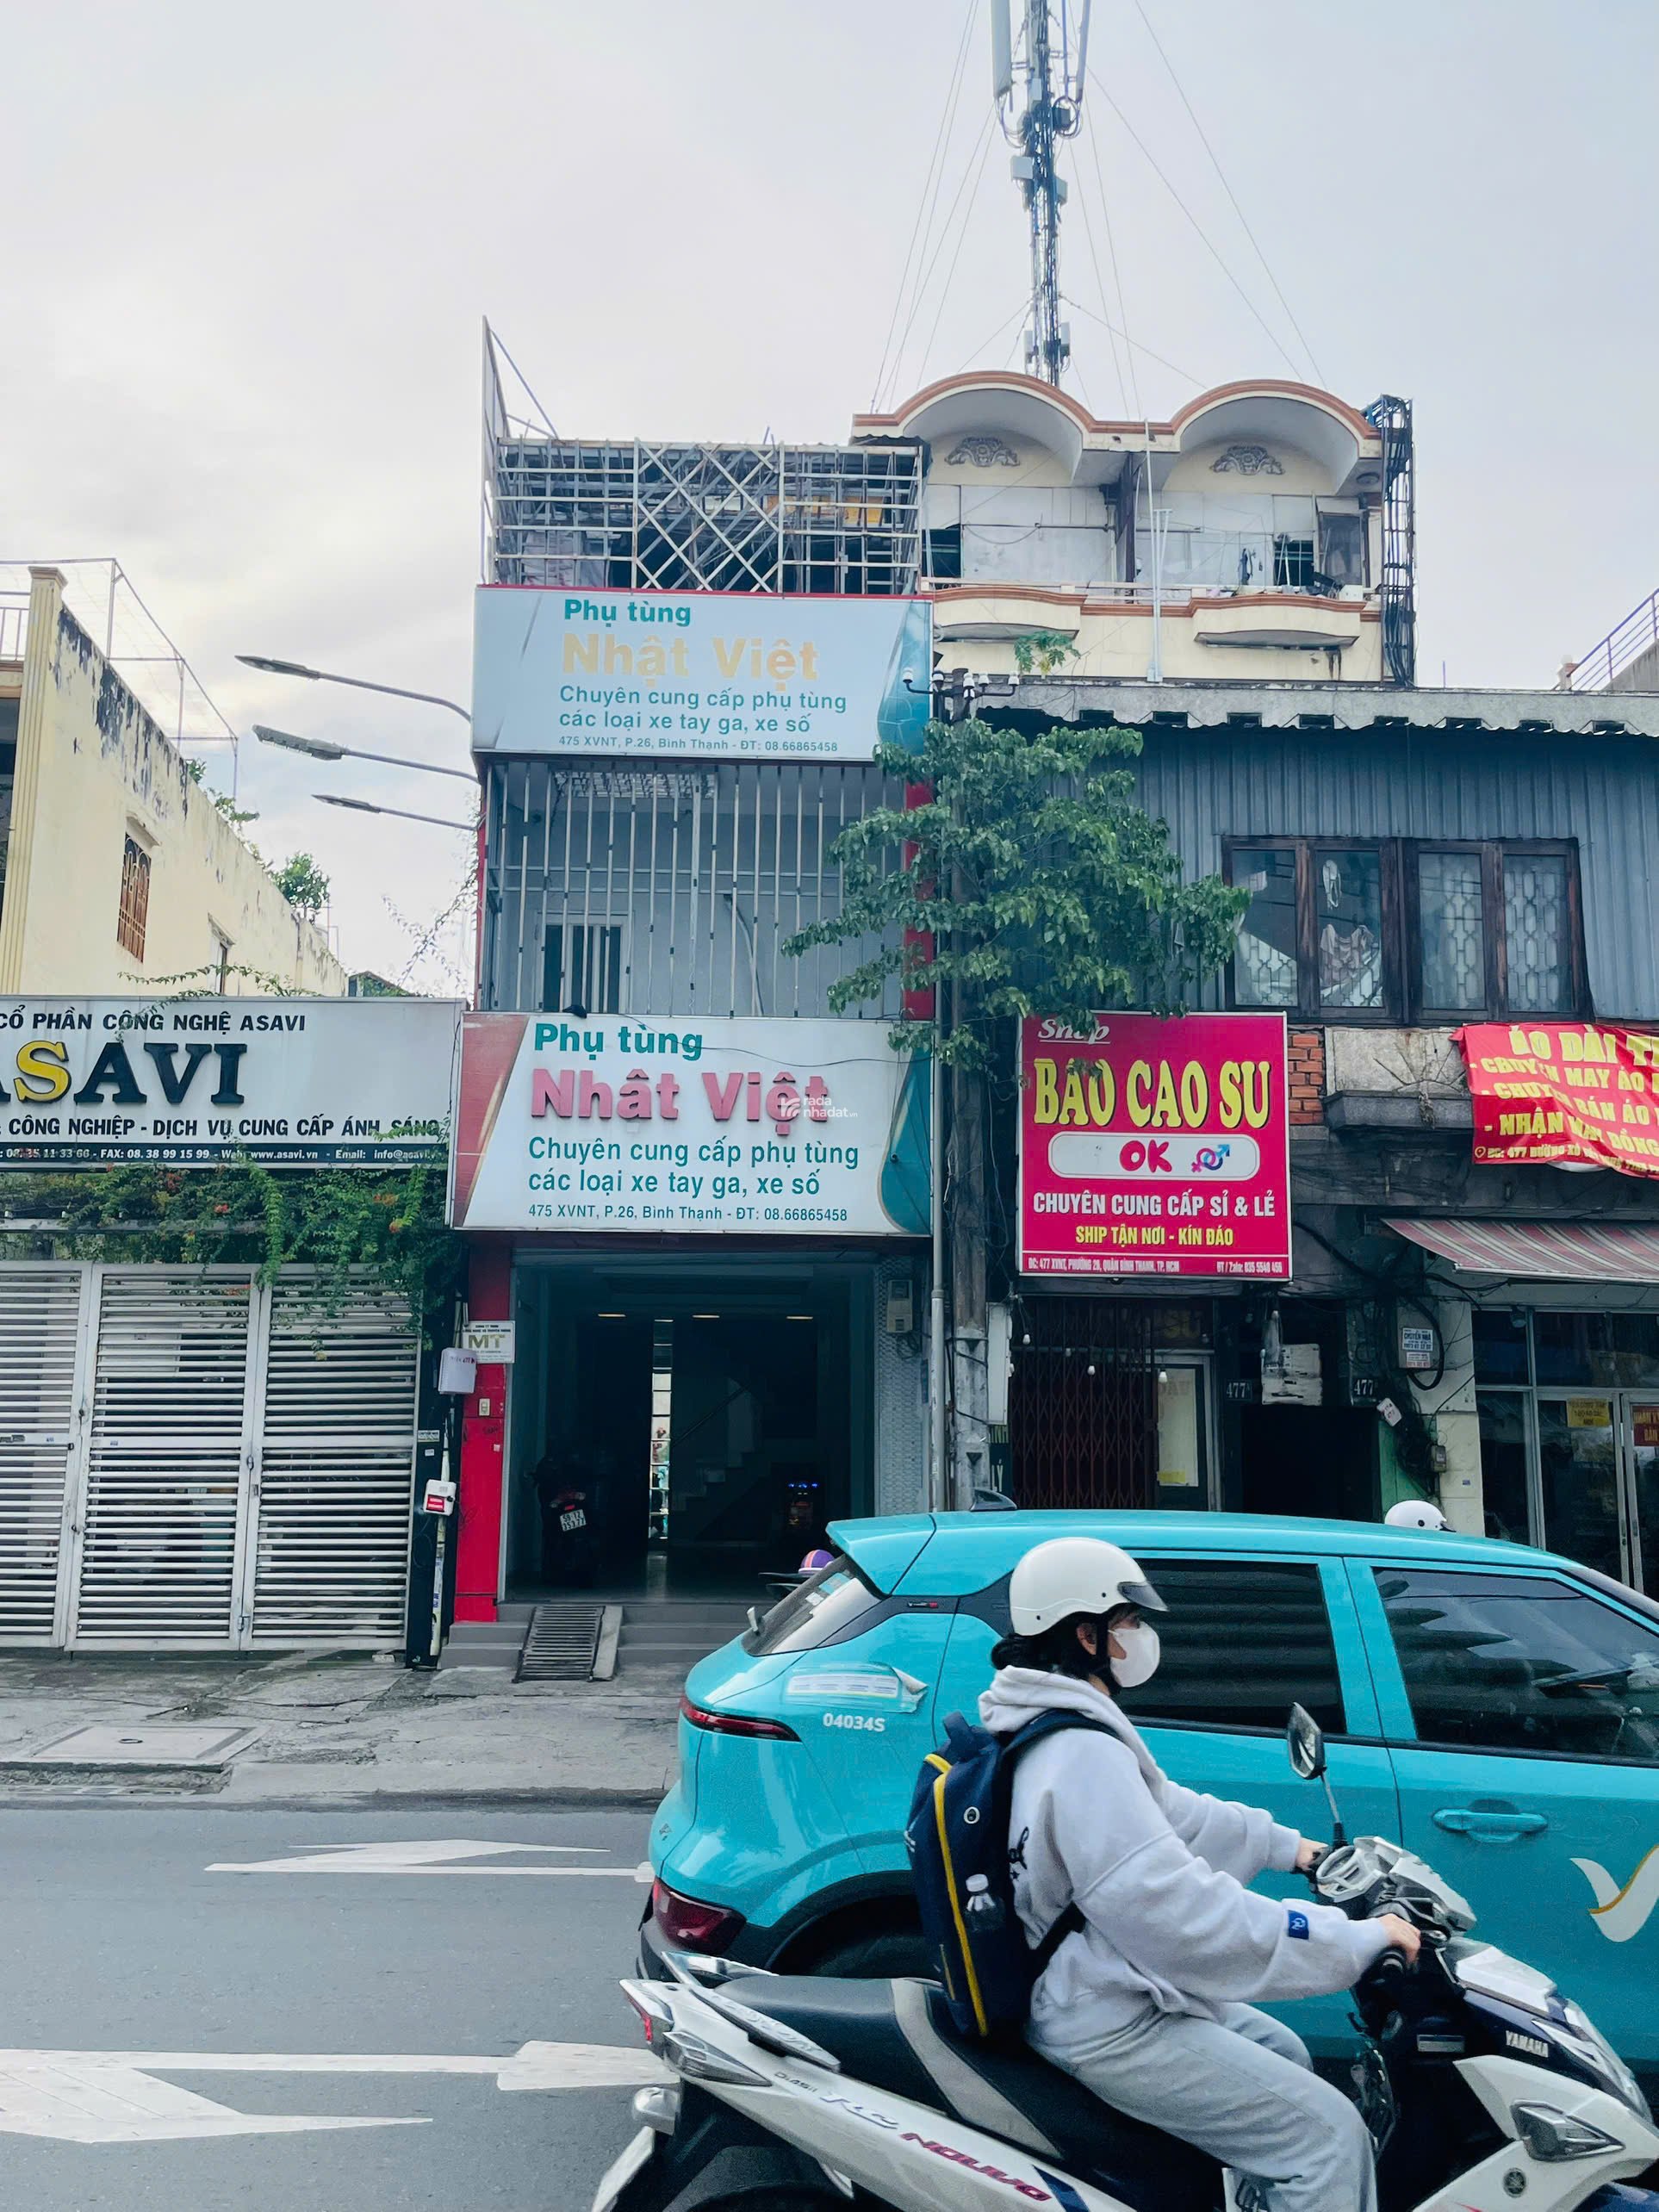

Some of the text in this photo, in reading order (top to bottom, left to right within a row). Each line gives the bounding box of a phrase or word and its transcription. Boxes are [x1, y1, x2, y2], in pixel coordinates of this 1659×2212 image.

[564, 599, 691, 628] Phụ tùng
[562, 632, 819, 692] Nhật Việt
[560, 685, 847, 713] Chuyên cung cấp phụ tùng
[559, 709, 811, 735] các loại xe tay ga, xe số
[559, 736, 580, 746] 475
[584, 736, 621, 748] XVNT,
[624, 737, 655, 749] P.26,
[658, 736, 686, 749] Bình
[689, 738, 729, 752] Thạnh
[740, 739, 762, 752] ĐT:
[765, 740, 838, 753] 08.66865458
[32, 1006, 93, 1030] PHẦN
[102, 1009, 165, 1032] CÔNG
[172, 1010, 232, 1035] NGHỆ
[239, 1014, 306, 1032] ASAVI
[533, 1022, 704, 1062] Phụ tùng
[1558, 1023, 1619, 1064] DÀI
[0, 1040, 248, 1104] SAVI
[1564, 1067, 1610, 1089] MAY
[701, 1071, 829, 1136] Việt
[1034, 1058, 1271, 1129] BAO CAO SU
[9, 1115, 60, 1135] CÔNG
[68, 1115, 135, 1139] NGHIỆP
[152, 1119, 197, 1140] DỊCH
[208, 1119, 232, 1140] VỤ
[238, 1119, 289, 1135] CUNG
[296, 1114, 334, 1136] CẤP
[341, 1115, 380, 1136] ÁNH
[1499, 1107, 1564, 1140] NHẬN
[100, 1148, 124, 1159] FAX:
[146, 1148, 159, 1159] 38
[163, 1148, 177, 1159] 99
[179, 1148, 193, 1159] 15
[196, 1148, 210, 1159] 99
[251, 1149, 318, 1159] www.asavi.vn
[335, 1148, 367, 1159] Email:
[528, 1134, 860, 1170] Chuyên cung cấp phụ tùng
[1119, 1139, 1172, 1173] OK
[1507, 1146, 1528, 1159] 477
[528, 1166, 821, 1199] các loại xe tay ga, xe số
[528, 1204, 553, 1217] 475
[556, 1204, 600, 1220] XVNT,
[604, 1205, 638, 1221] P.26,
[642, 1205, 674, 1220] Bình
[679, 1207, 723, 1223] Thạnh
[736, 1207, 761, 1221] ĐT:
[763, 1208, 848, 1222] 08.66865458
[1033, 1189, 1276, 1217] CHUYÊN CUNG CẤP SỈ & LẺ
[1075, 1225, 1108, 1244] SHIP
[1110, 1223, 1138, 1248] TẬN
[1140, 1226, 1165, 1246] NƠI
[1177, 1222, 1202, 1246] KÍN
[1206, 1223, 1233, 1246] ĐÁO
[1040, 1258, 1050, 1270] 477
[822, 1712, 886, 1733] 04034S
[1505, 2029, 1550, 2059] YAMAHA
